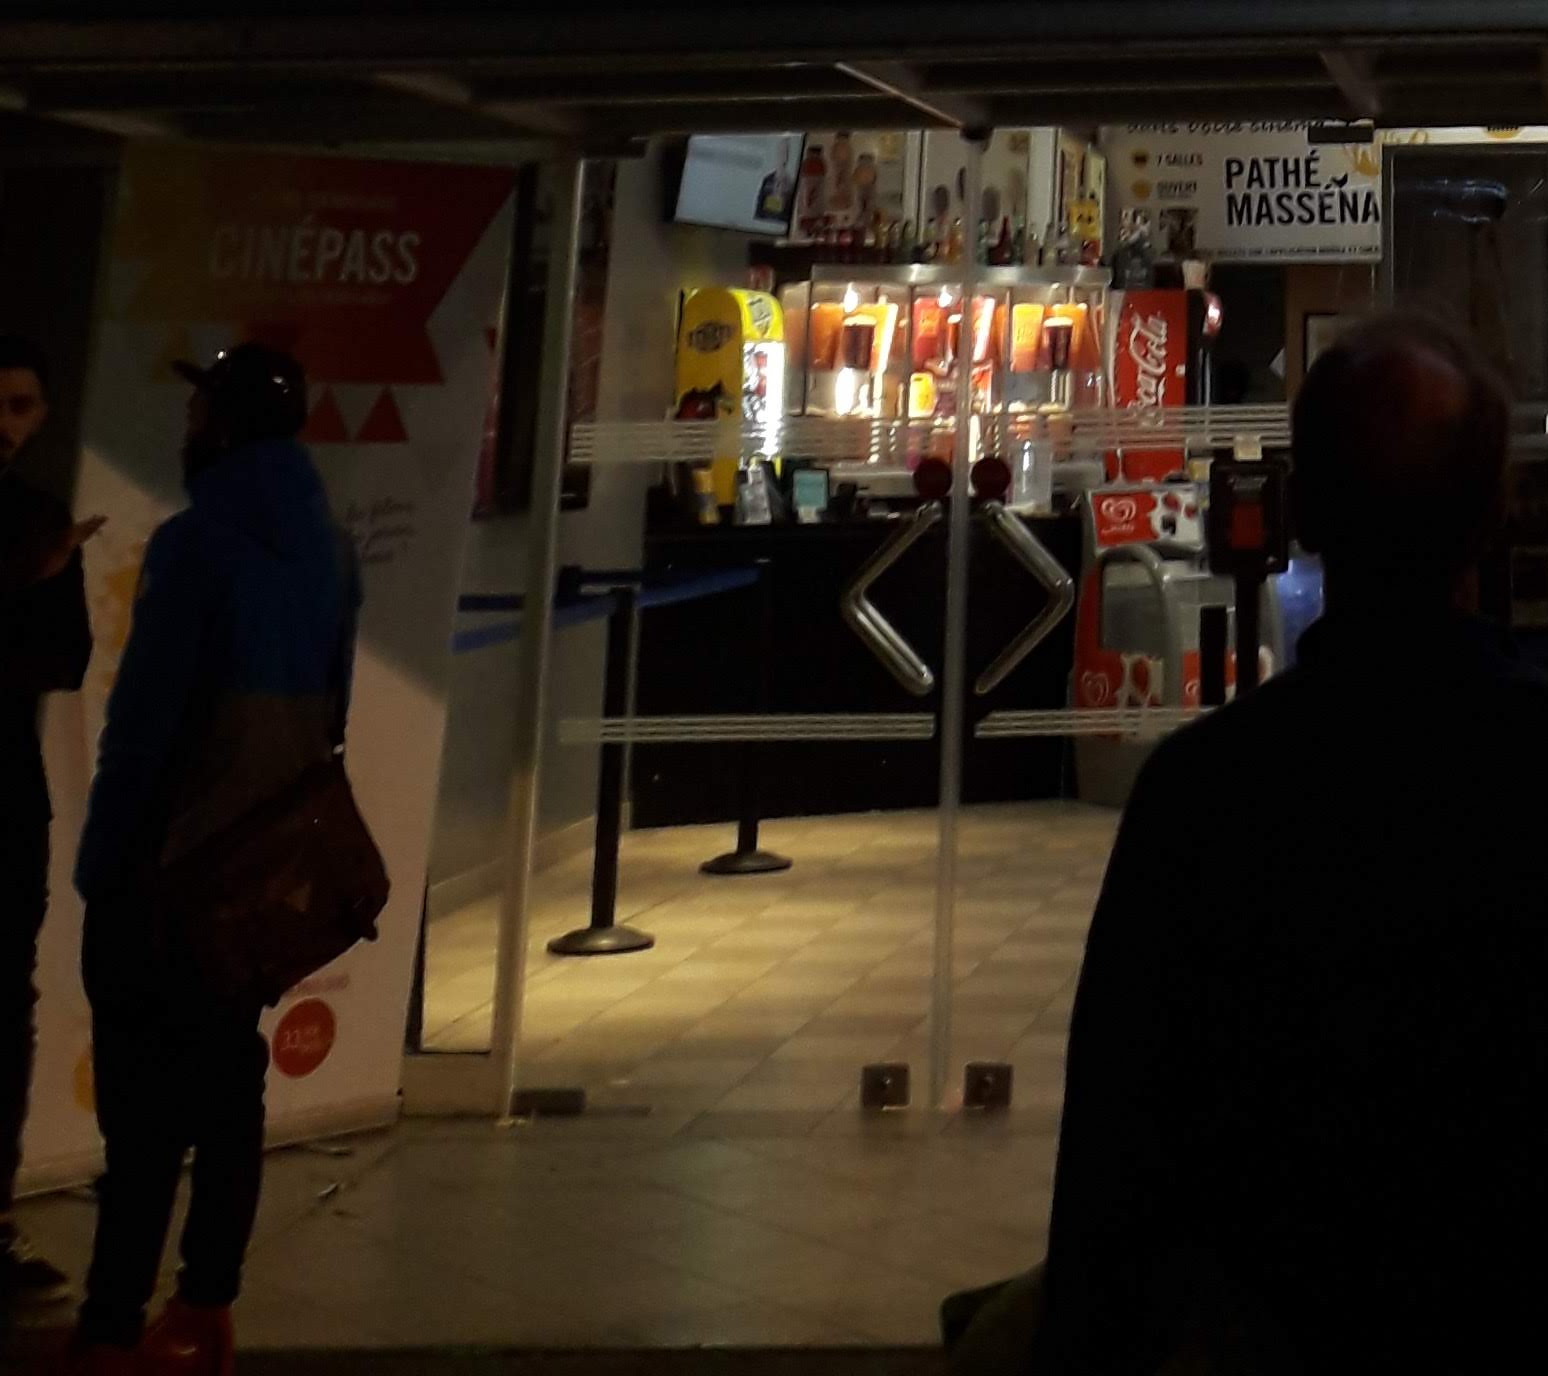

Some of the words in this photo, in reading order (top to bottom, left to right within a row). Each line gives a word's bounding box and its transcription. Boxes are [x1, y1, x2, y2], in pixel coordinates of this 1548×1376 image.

[1226, 149, 1320, 189] PATHÉ
[1227, 183, 1380, 226] MASSÉNA
[210, 213, 422, 286] CINÉPASS
